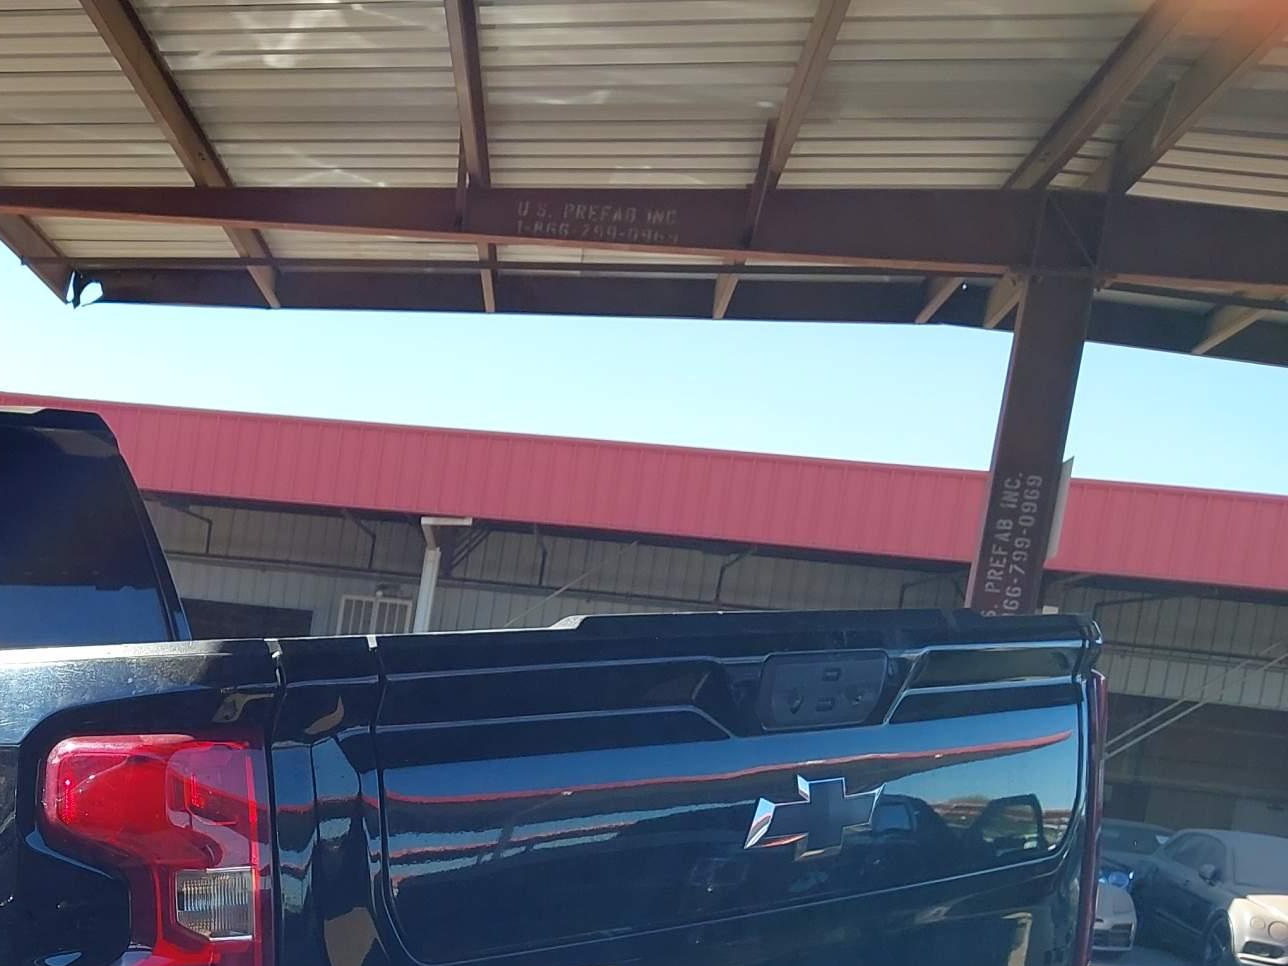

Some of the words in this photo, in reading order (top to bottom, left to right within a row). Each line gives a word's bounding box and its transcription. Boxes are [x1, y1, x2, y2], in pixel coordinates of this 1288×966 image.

[984, 518, 1014, 593] PREFAB
[1000, 472, 1024, 509] INC.
[1001, 474, 1044, 616] 66-799-0969
